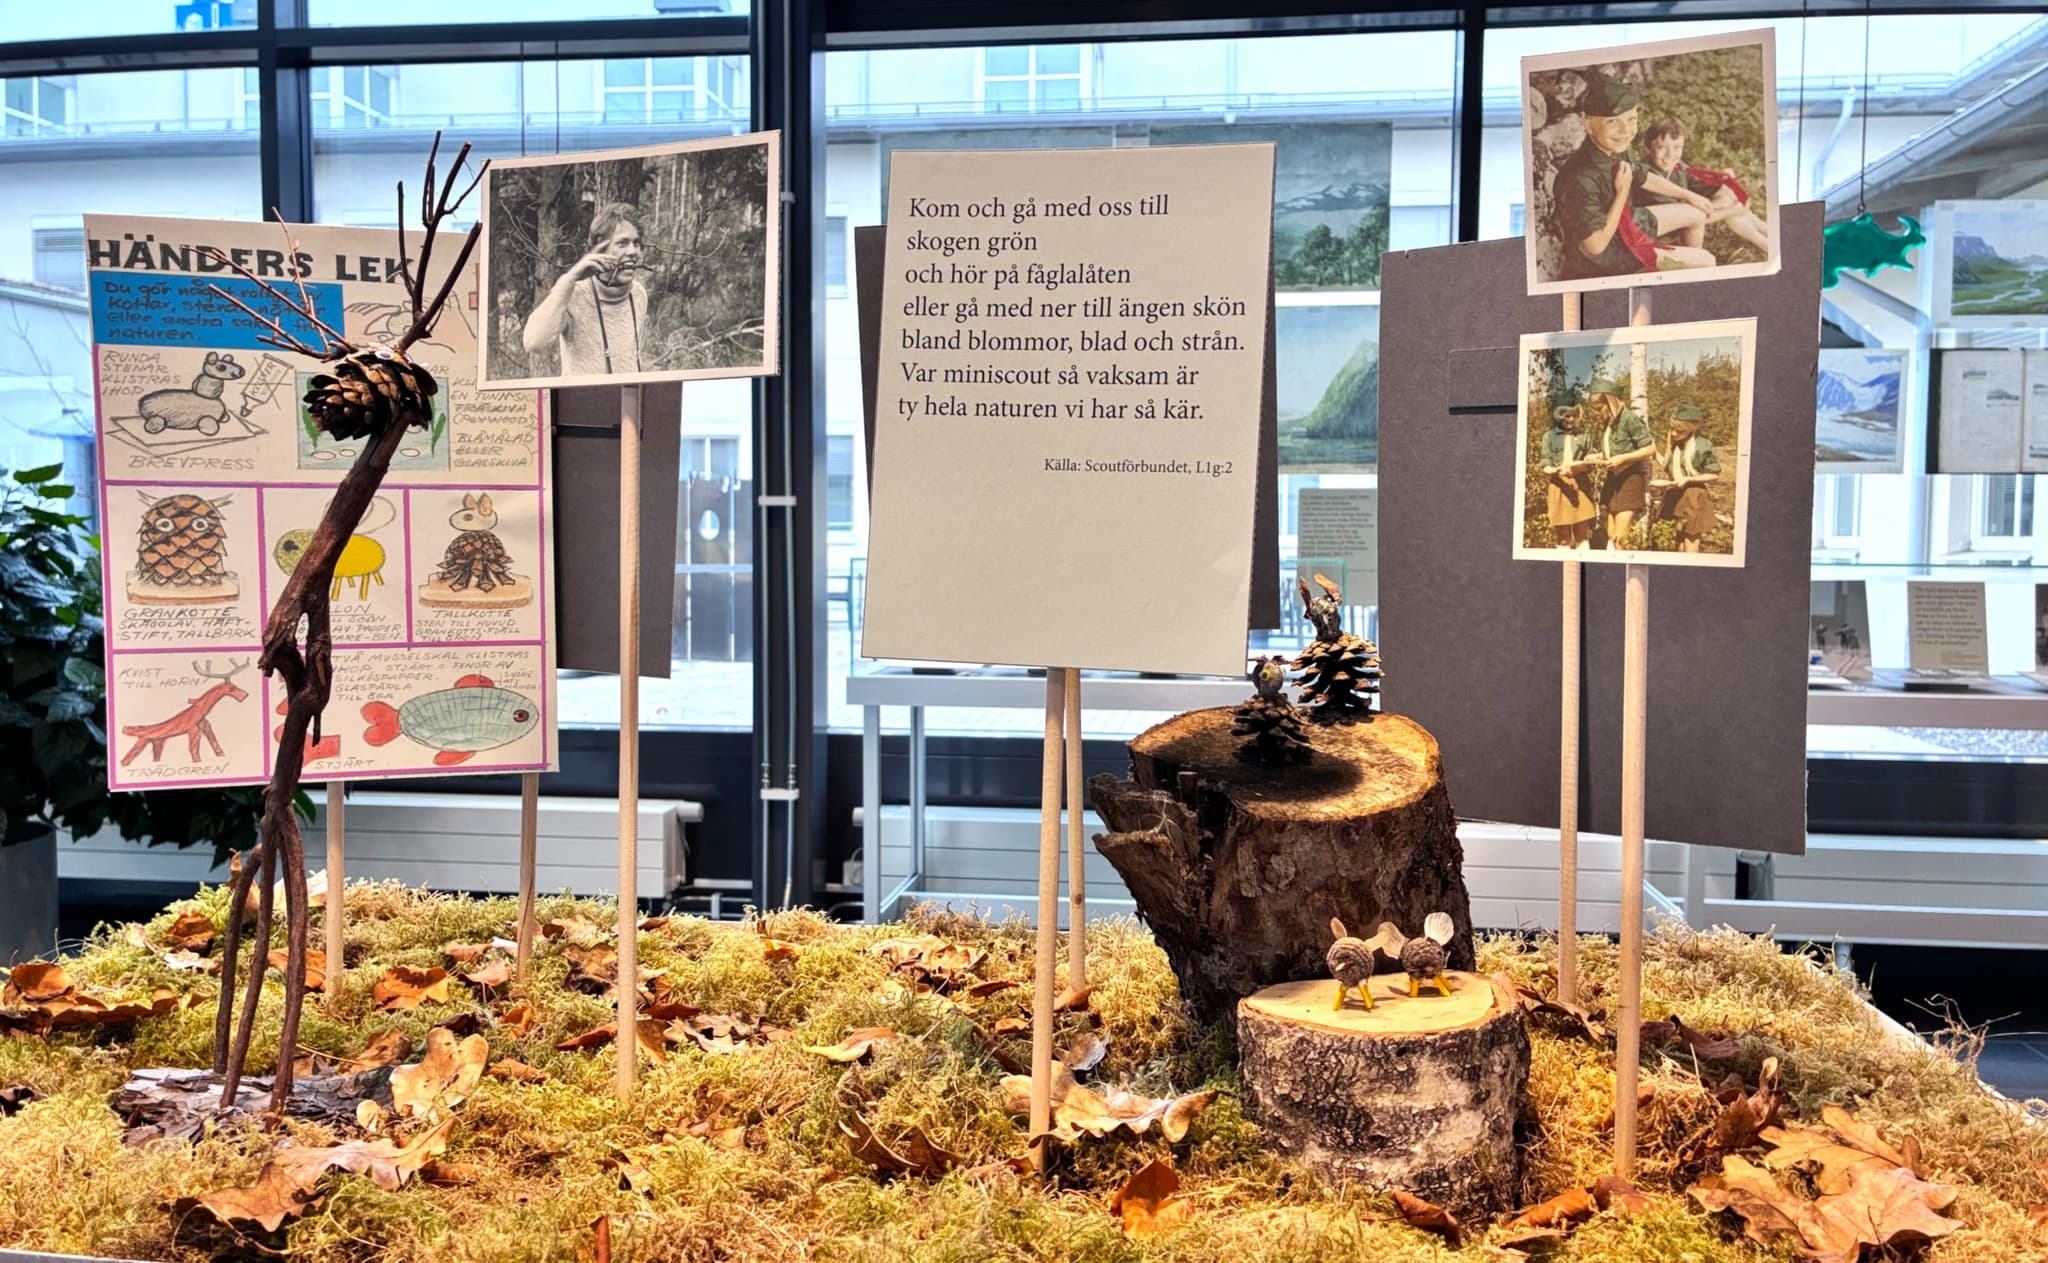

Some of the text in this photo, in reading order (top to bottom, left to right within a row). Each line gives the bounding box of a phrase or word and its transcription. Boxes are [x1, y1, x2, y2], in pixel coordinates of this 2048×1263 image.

[909, 193, 1169, 225] Kom och gå med oss till
[906, 229, 1038, 258] skogen grön
[88, 233, 415, 283] HÄNDERS LEK
[904, 262, 1131, 291] och hör på fåglalåten
[104, 281, 131, 295] Du
[903, 295, 1246, 324] eller gå med ner till ängen skön
[107, 311, 152, 323] eller
[162, 313, 223, 327] andra
[902, 328, 1245, 354] bland blommor, blad och strån.
[104, 350, 161, 363] RUNDA
[102, 362, 169, 374] STENAR
[900, 362, 1200, 386] Var miniscout så vaksam är
[101, 374, 182, 385] KLISTRAS
[103, 386, 145, 396] IHOP
[898, 394, 1204, 422] ty hela naturen vi har så kär.
[128, 455, 255, 471] BREVPRESS
[1044, 458, 1081, 472] Källa:
[1084, 459, 1192, 474] Scoutförbundet,
[124, 606, 238, 619] GRANKOTTE
[432, 609, 514, 619] TALLKOTTE
[176, 628, 256, 640] TALLBARK
[465, 650, 529, 660] KLISTRAS
[159, 677, 200, 687] HORN
[126, 762, 229, 777] TRÄDGREN
